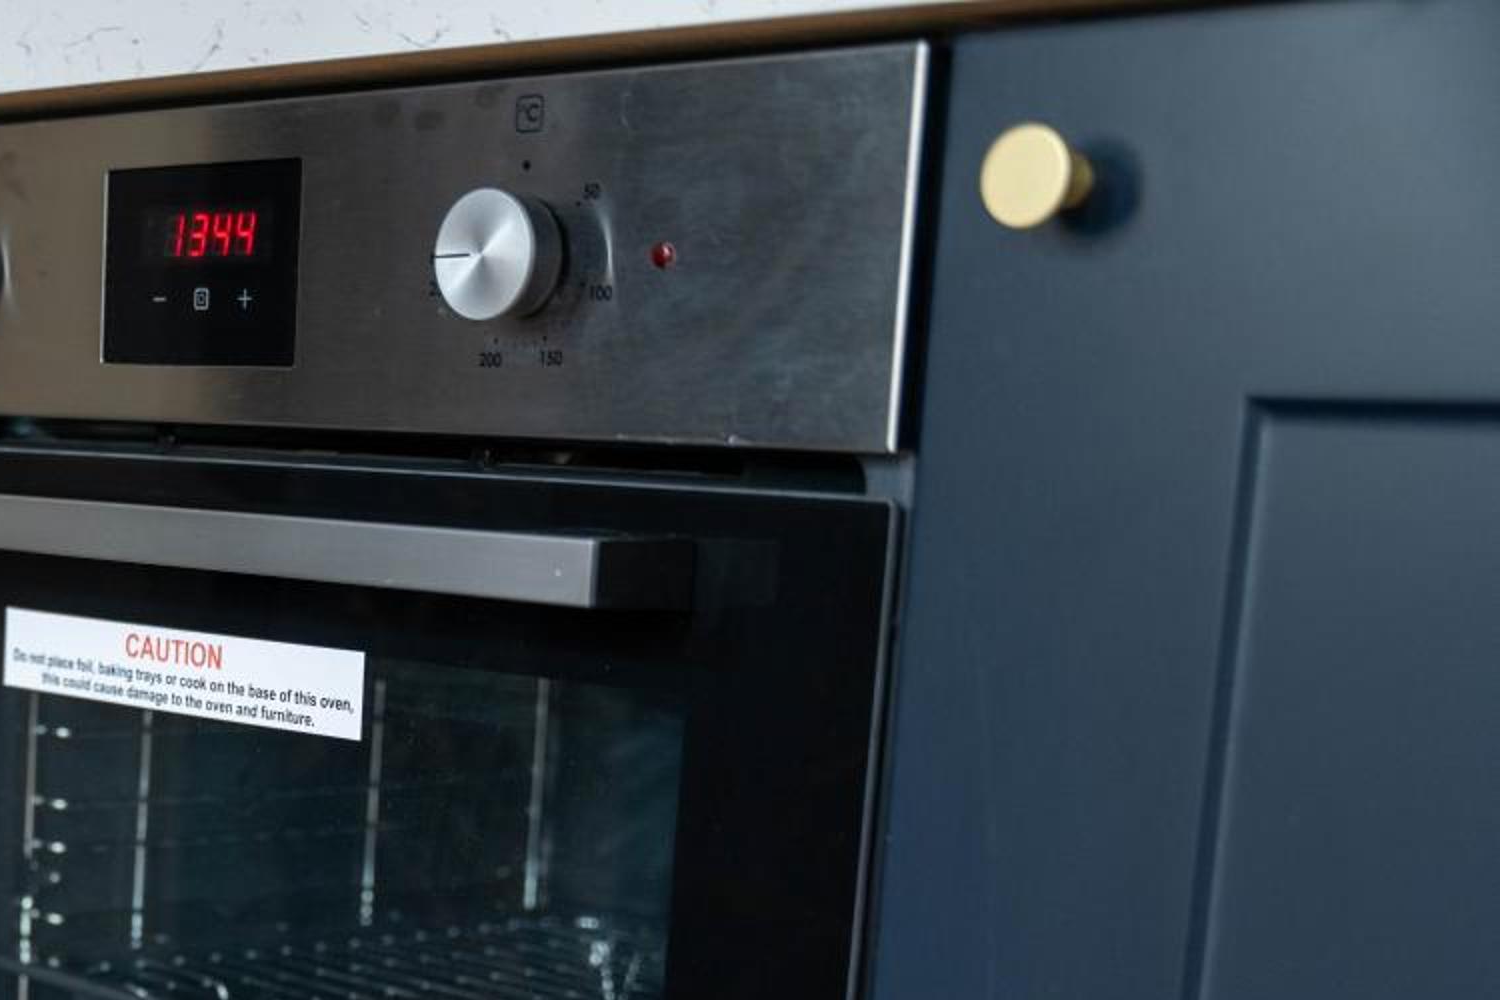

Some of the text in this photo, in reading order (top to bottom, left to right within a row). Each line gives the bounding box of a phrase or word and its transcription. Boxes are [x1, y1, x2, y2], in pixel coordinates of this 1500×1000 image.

[583, 183, 600, 200] 50
[174, 211, 257, 257] 1344
[589, 285, 613, 301] 100
[479, 352, 503, 369] 200
[538, 350, 564, 367] 150
[125, 633, 223, 670] CAUTION
[98, 661, 133, 682] baking
[136, 669, 162, 686] trays
[165, 674, 177, 685] or
[180, 677, 206, 690] cook
[209, 681, 224, 693] on
[228, 682, 245, 696] the
[248, 684, 276, 701] base
[279, 689, 292, 703] of
[294, 689, 316, 707] this
[319, 697, 354, 714] oven,
[63, 677, 91, 691] could
[93, 682, 124, 696] cause
[126, 685, 169, 707] damage
[171, 693, 182, 706] to
[185, 695, 203, 710] the
[205, 701, 233, 713] oven
[235, 703, 258, 718] and
[261, 705, 315, 727] furniture.
